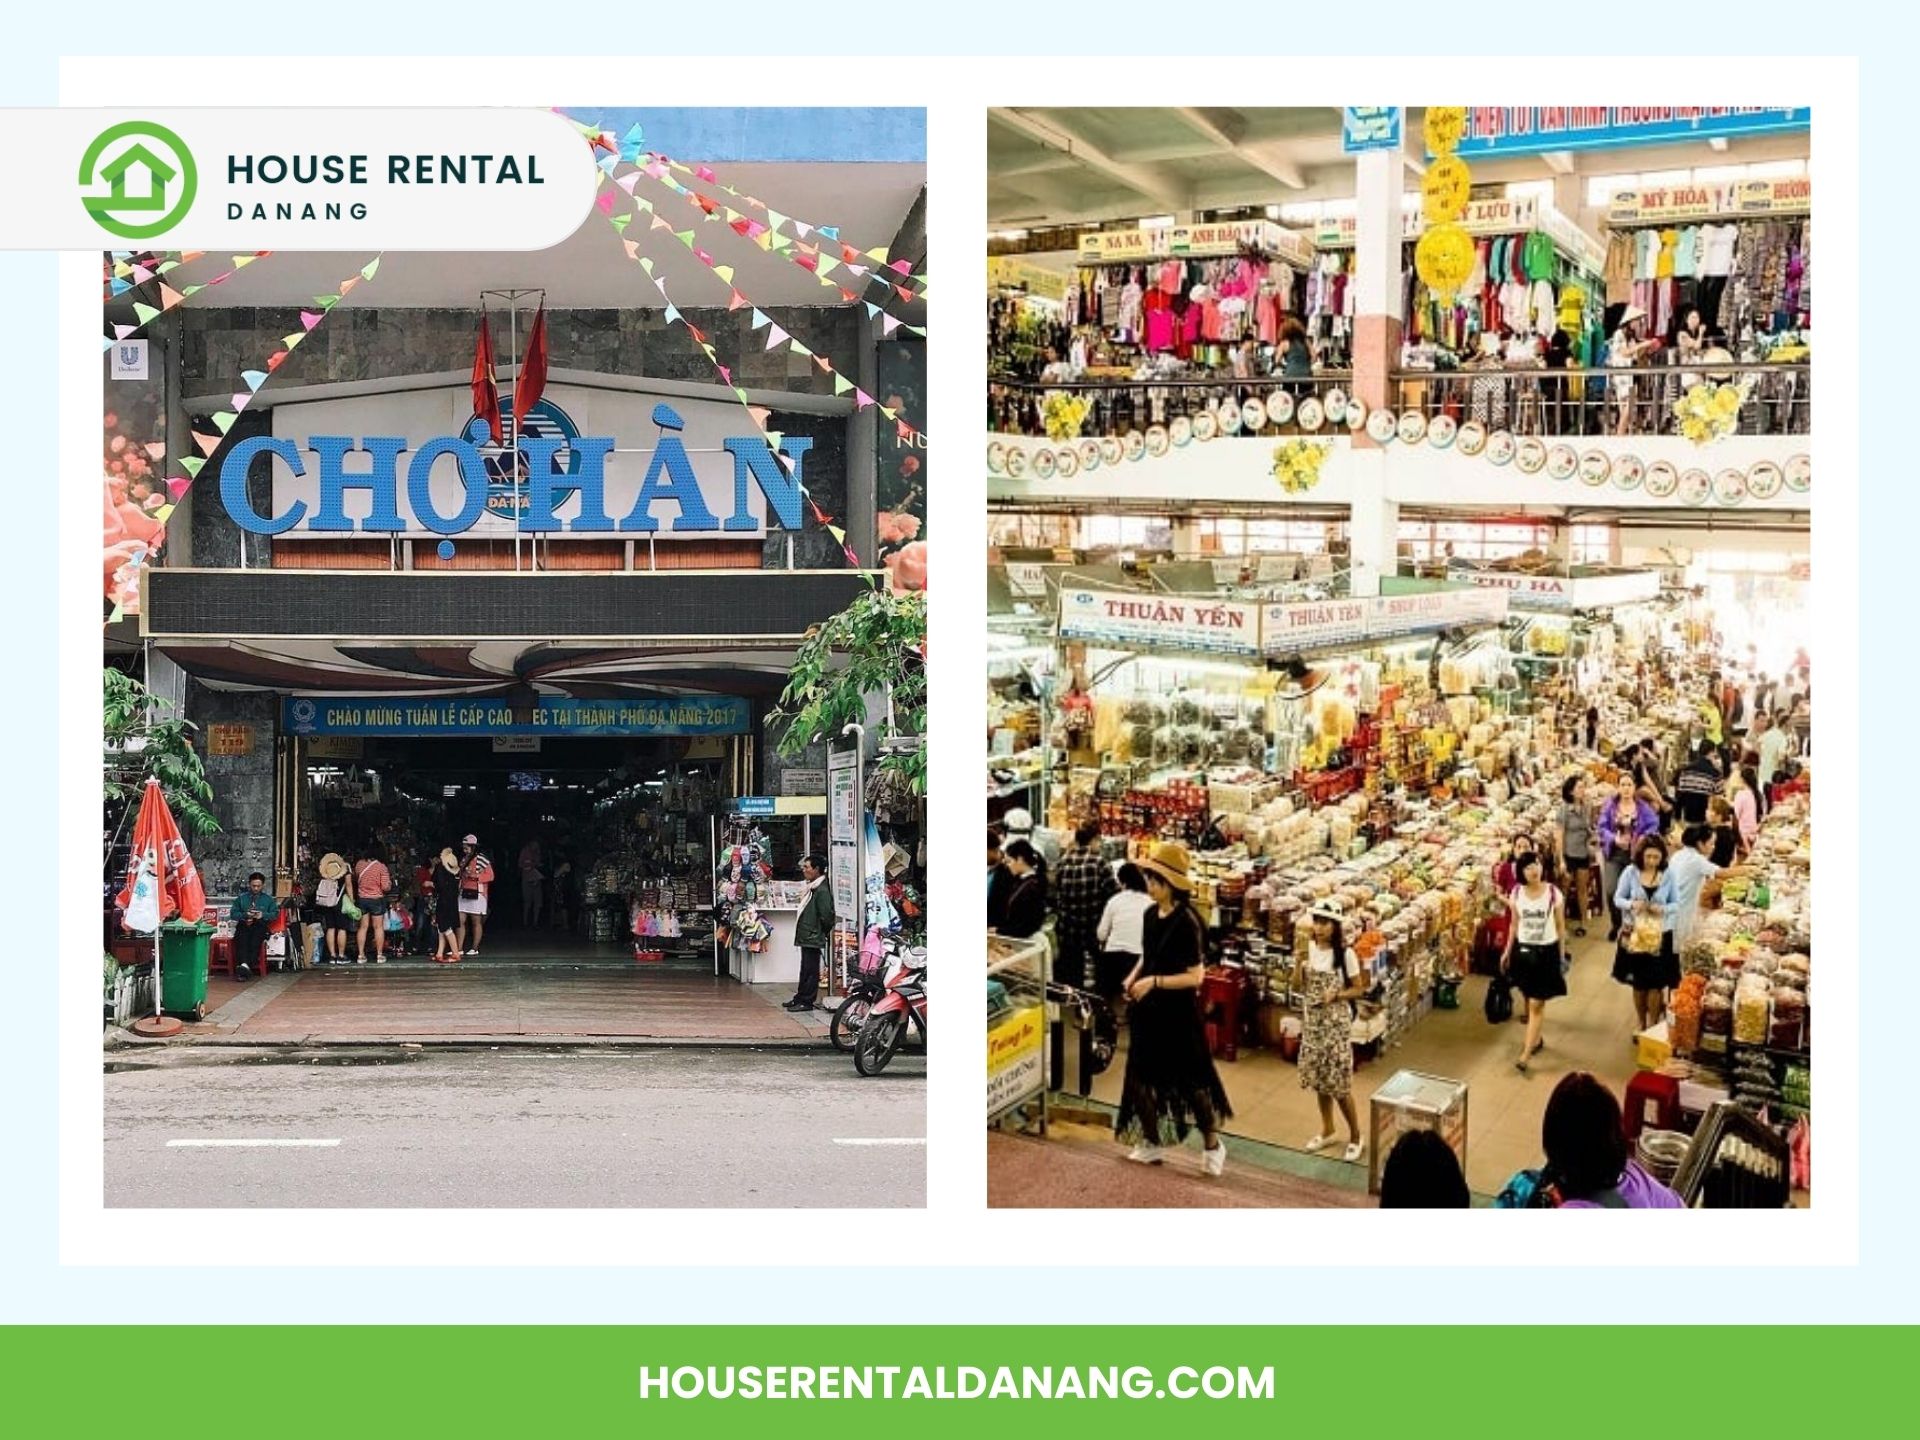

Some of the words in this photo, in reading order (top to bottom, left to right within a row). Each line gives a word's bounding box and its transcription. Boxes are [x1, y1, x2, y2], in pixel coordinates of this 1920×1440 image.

[219, 418, 490, 560] CHỢ
[518, 402, 814, 532] HÀN
[1104, 600, 1184, 625] THUẬN
[327, 705, 361, 726] CHÀO
[459, 702, 484, 726] CẤP
[488, 708, 513, 726] CAO
[706, 708, 737, 726] 2017
